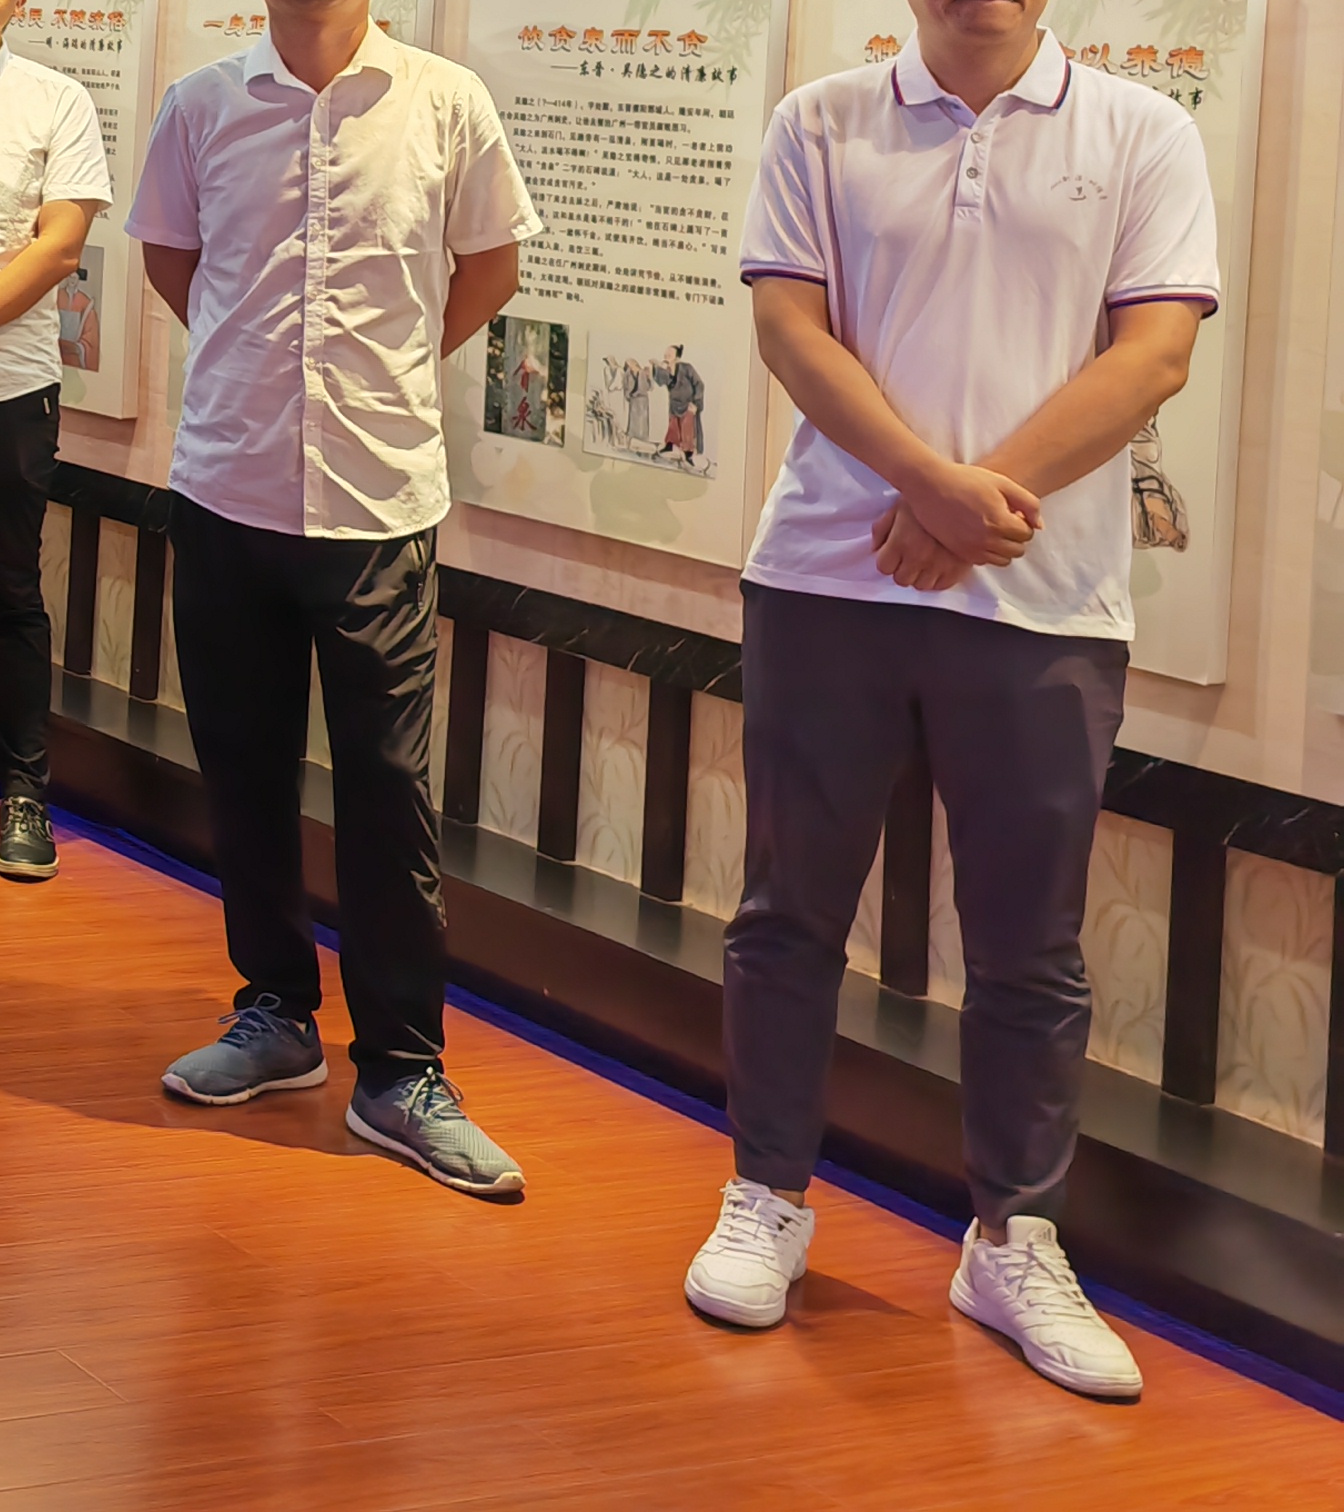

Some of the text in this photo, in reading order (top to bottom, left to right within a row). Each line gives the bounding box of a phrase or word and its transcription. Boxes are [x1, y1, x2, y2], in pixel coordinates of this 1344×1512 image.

[50, 8, 126, 32] 不随流俗
[517, 24, 708, 58] 饮贪泉而不贪
